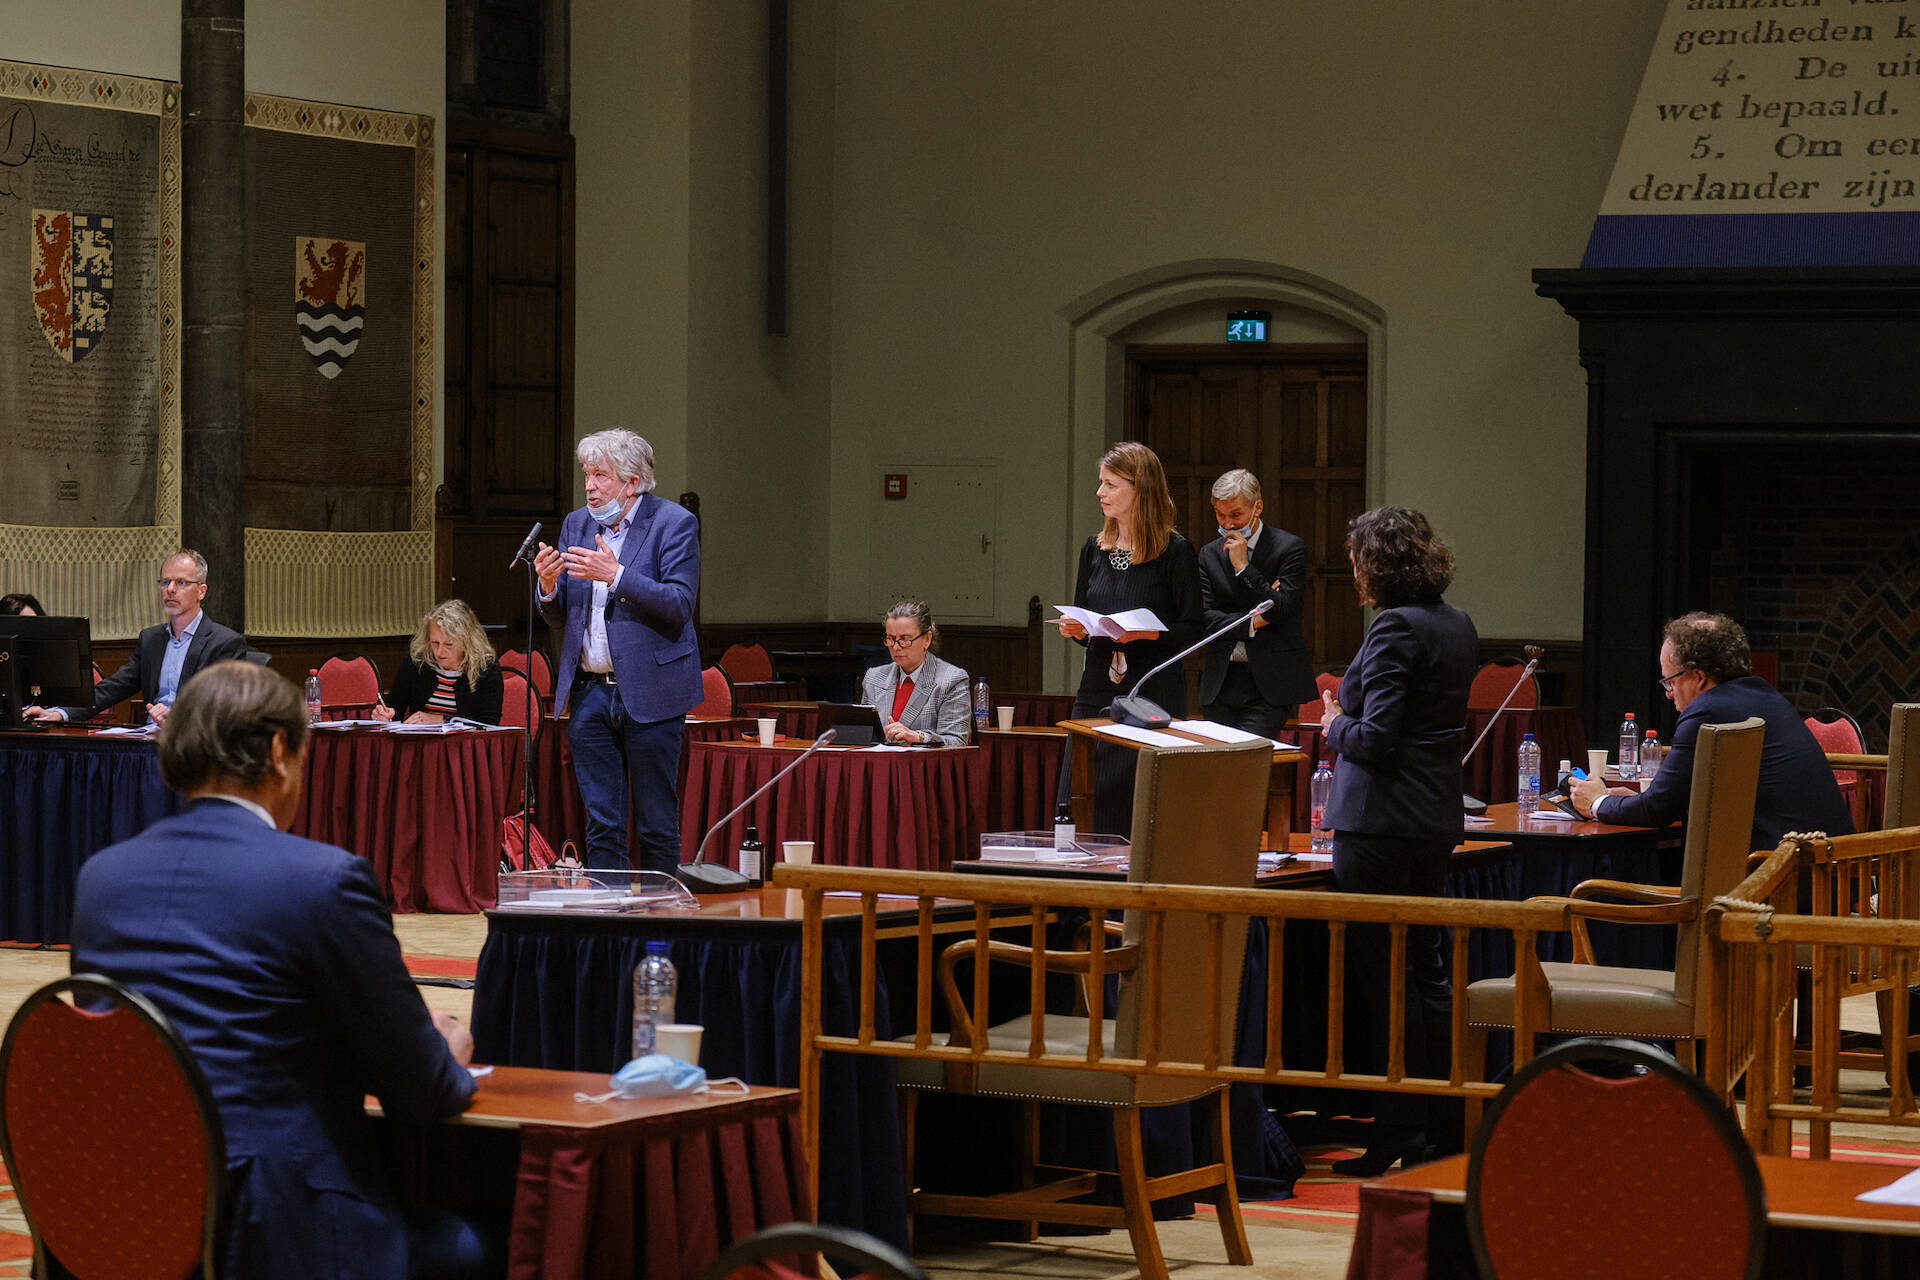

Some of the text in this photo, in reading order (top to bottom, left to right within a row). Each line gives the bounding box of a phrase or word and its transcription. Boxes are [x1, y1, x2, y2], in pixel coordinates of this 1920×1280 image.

[1673, 18, 1873, 54] gendheden
[1711, 59, 1746, 87] 4.
[1795, 56, 1848, 80] De
[1656, 90, 1899, 128] wet bepaald.
[1690, 134, 1725, 159] 5.
[1774, 133, 1842, 159] Om
[1629, 169, 1915, 208] derlander zijn
